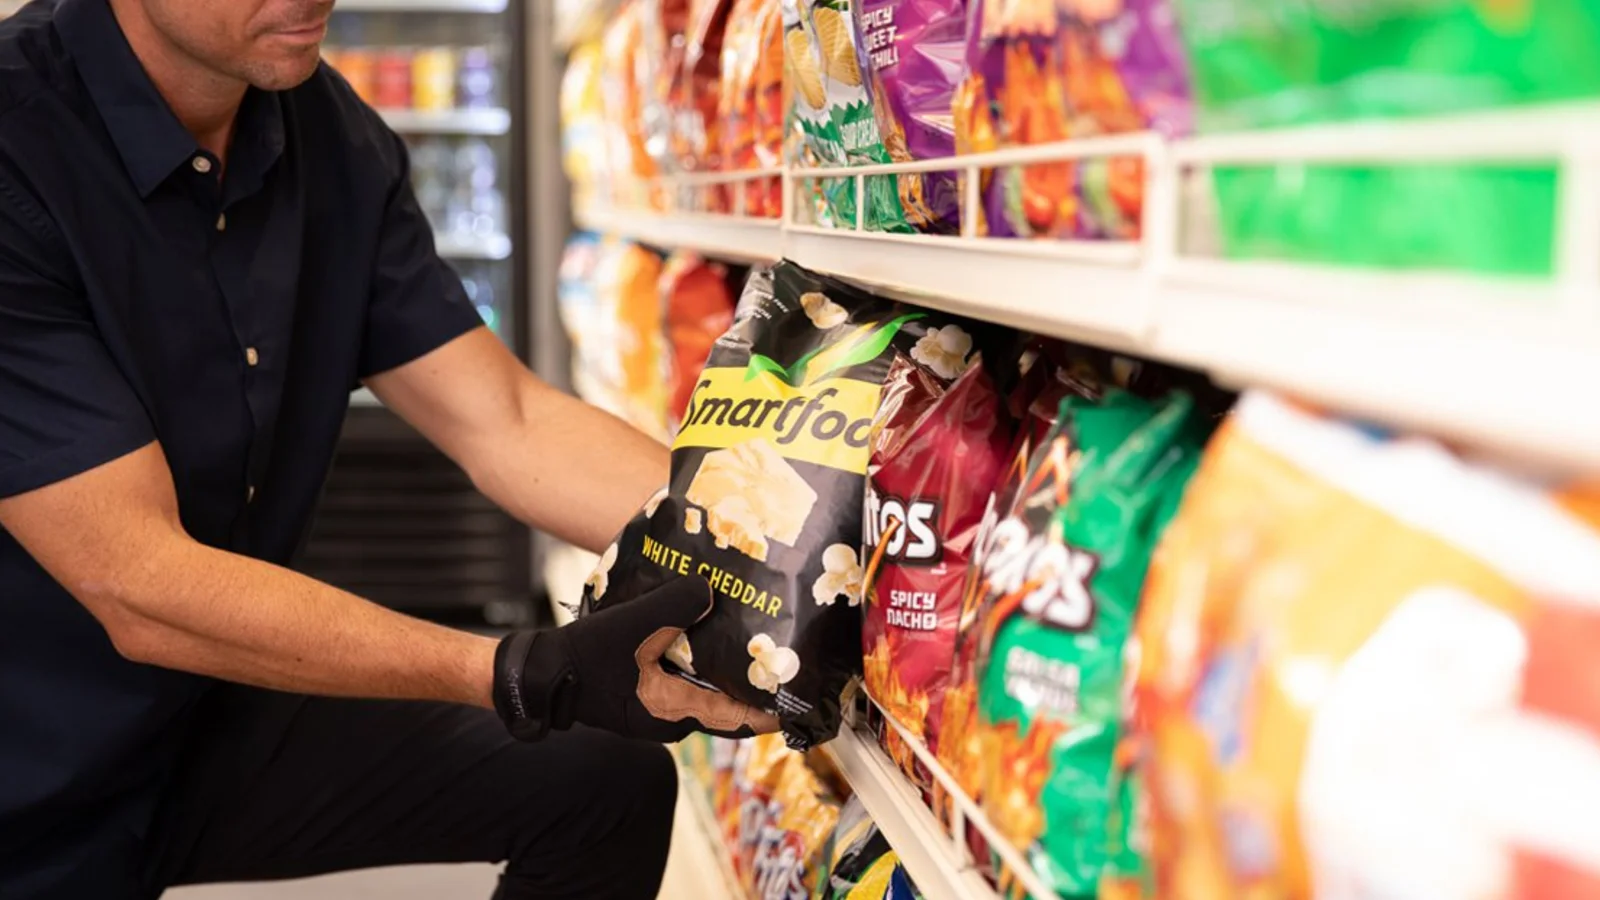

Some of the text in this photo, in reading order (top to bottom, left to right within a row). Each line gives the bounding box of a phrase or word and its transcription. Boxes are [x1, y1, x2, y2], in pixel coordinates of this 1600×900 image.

[676, 379, 872, 448] Smartfoo
[641, 534, 692, 576] WHITE
[890, 589, 936, 611] SPICY
[886, 608, 938, 631] NACHO
